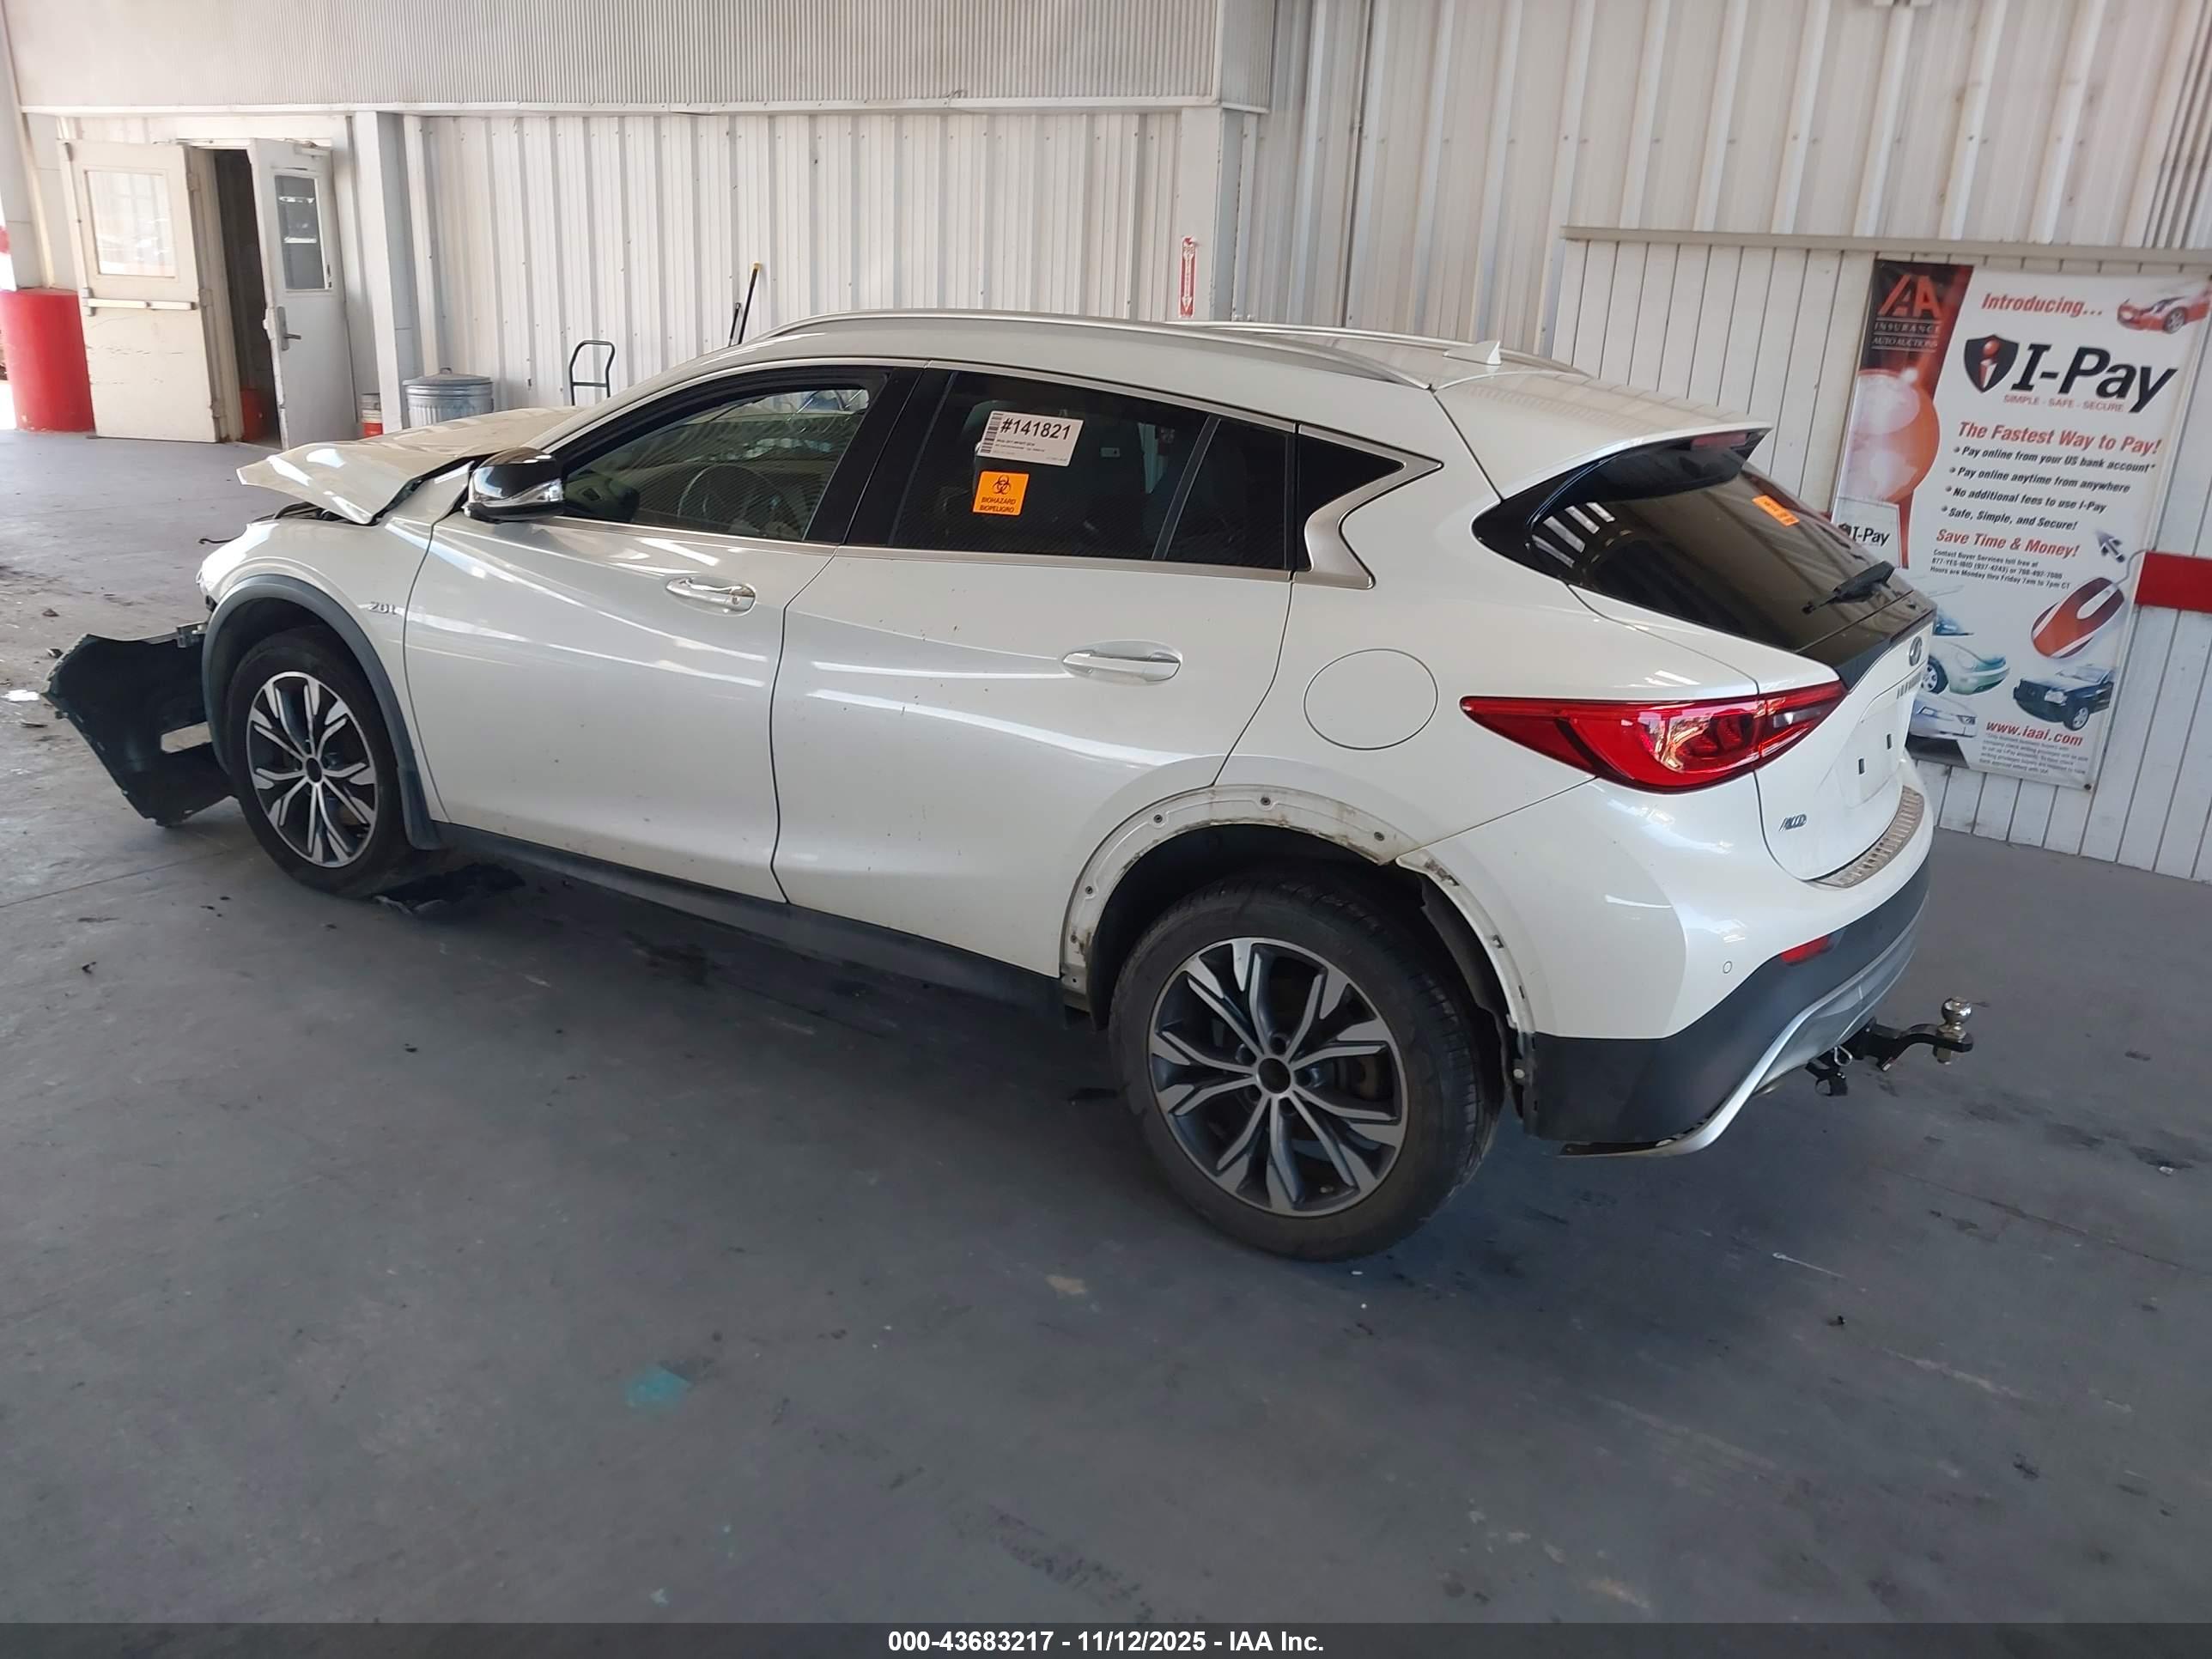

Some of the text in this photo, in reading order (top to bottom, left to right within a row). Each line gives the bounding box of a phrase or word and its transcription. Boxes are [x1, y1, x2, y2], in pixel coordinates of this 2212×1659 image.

[1981, 293, 2103, 318] Introducing...
[1875, 322, 1940, 334] INSURANCE
[2010, 343, 2179, 414] I-Pay
[2003, 394, 2039, 406] SIMPLE
[2048, 398, 2074, 409] SAFE
[2082, 401, 2124, 413] SECURE
[1000, 418, 1072, 441] #141821
[1959, 422, 2162, 457] The Fastest Way to Pay!
[1961, 446, 1981, 459] Pay
[1982, 448, 2013, 460] online
[2014, 451, 2039, 462] from
[2039, 455, 2063, 465] your
[2064, 455, 2079, 465] US
[2079, 457, 2106, 468] bank
[1958, 466, 2131, 493] Pay online anytime from anywhere
[980, 504, 1015, 514] BIOPELIGRO
[981, 496, 1017, 505] BIOHAZARD
[1953, 487, 2107, 514] No additional fees to use I-Pay
[1948, 507, 2079, 531] Safe, Simple, and Secure!
[1853, 526, 1891, 547] I-Pay
[1936, 529, 2080, 559] Save Time & Money!
[1934, 549, 1957, 557] Contact
[1958, 552, 1976, 561] Buyer
[1977, 554, 2003, 563] Services
[1930, 566, 1948, 574] Hours
[1961, 569, 1986, 580] Monday
[2001, 574, 2021, 585] Friday
[1985, 721, 2084, 746] www.iaai.com
